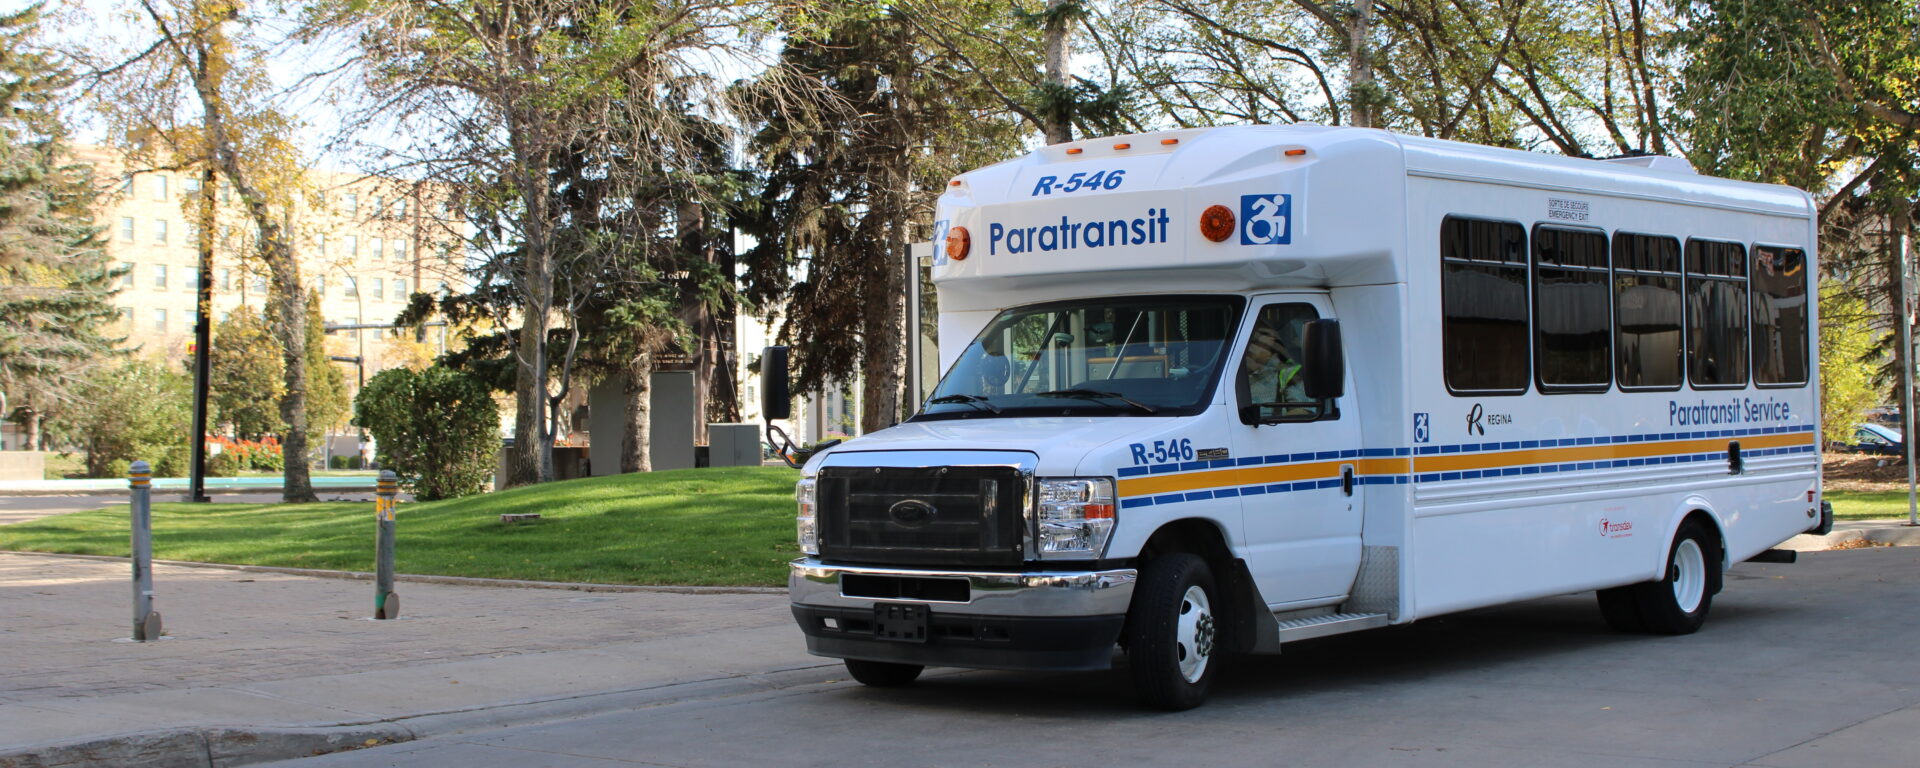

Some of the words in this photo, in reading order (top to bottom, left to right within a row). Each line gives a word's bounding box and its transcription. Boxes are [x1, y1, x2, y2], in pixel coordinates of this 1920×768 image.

[1031, 169, 1126, 196] R-546
[1549, 209, 1578, 220] EMERGENCY
[1579, 212, 1589, 221] EXIT
[990, 208, 1169, 255] Paratransit
[1488, 414, 1512, 425] REGINA
[1669, 397, 1740, 426] Paratransit
[1744, 396, 1790, 423] Service
[1129, 438, 1193, 465] R-546
